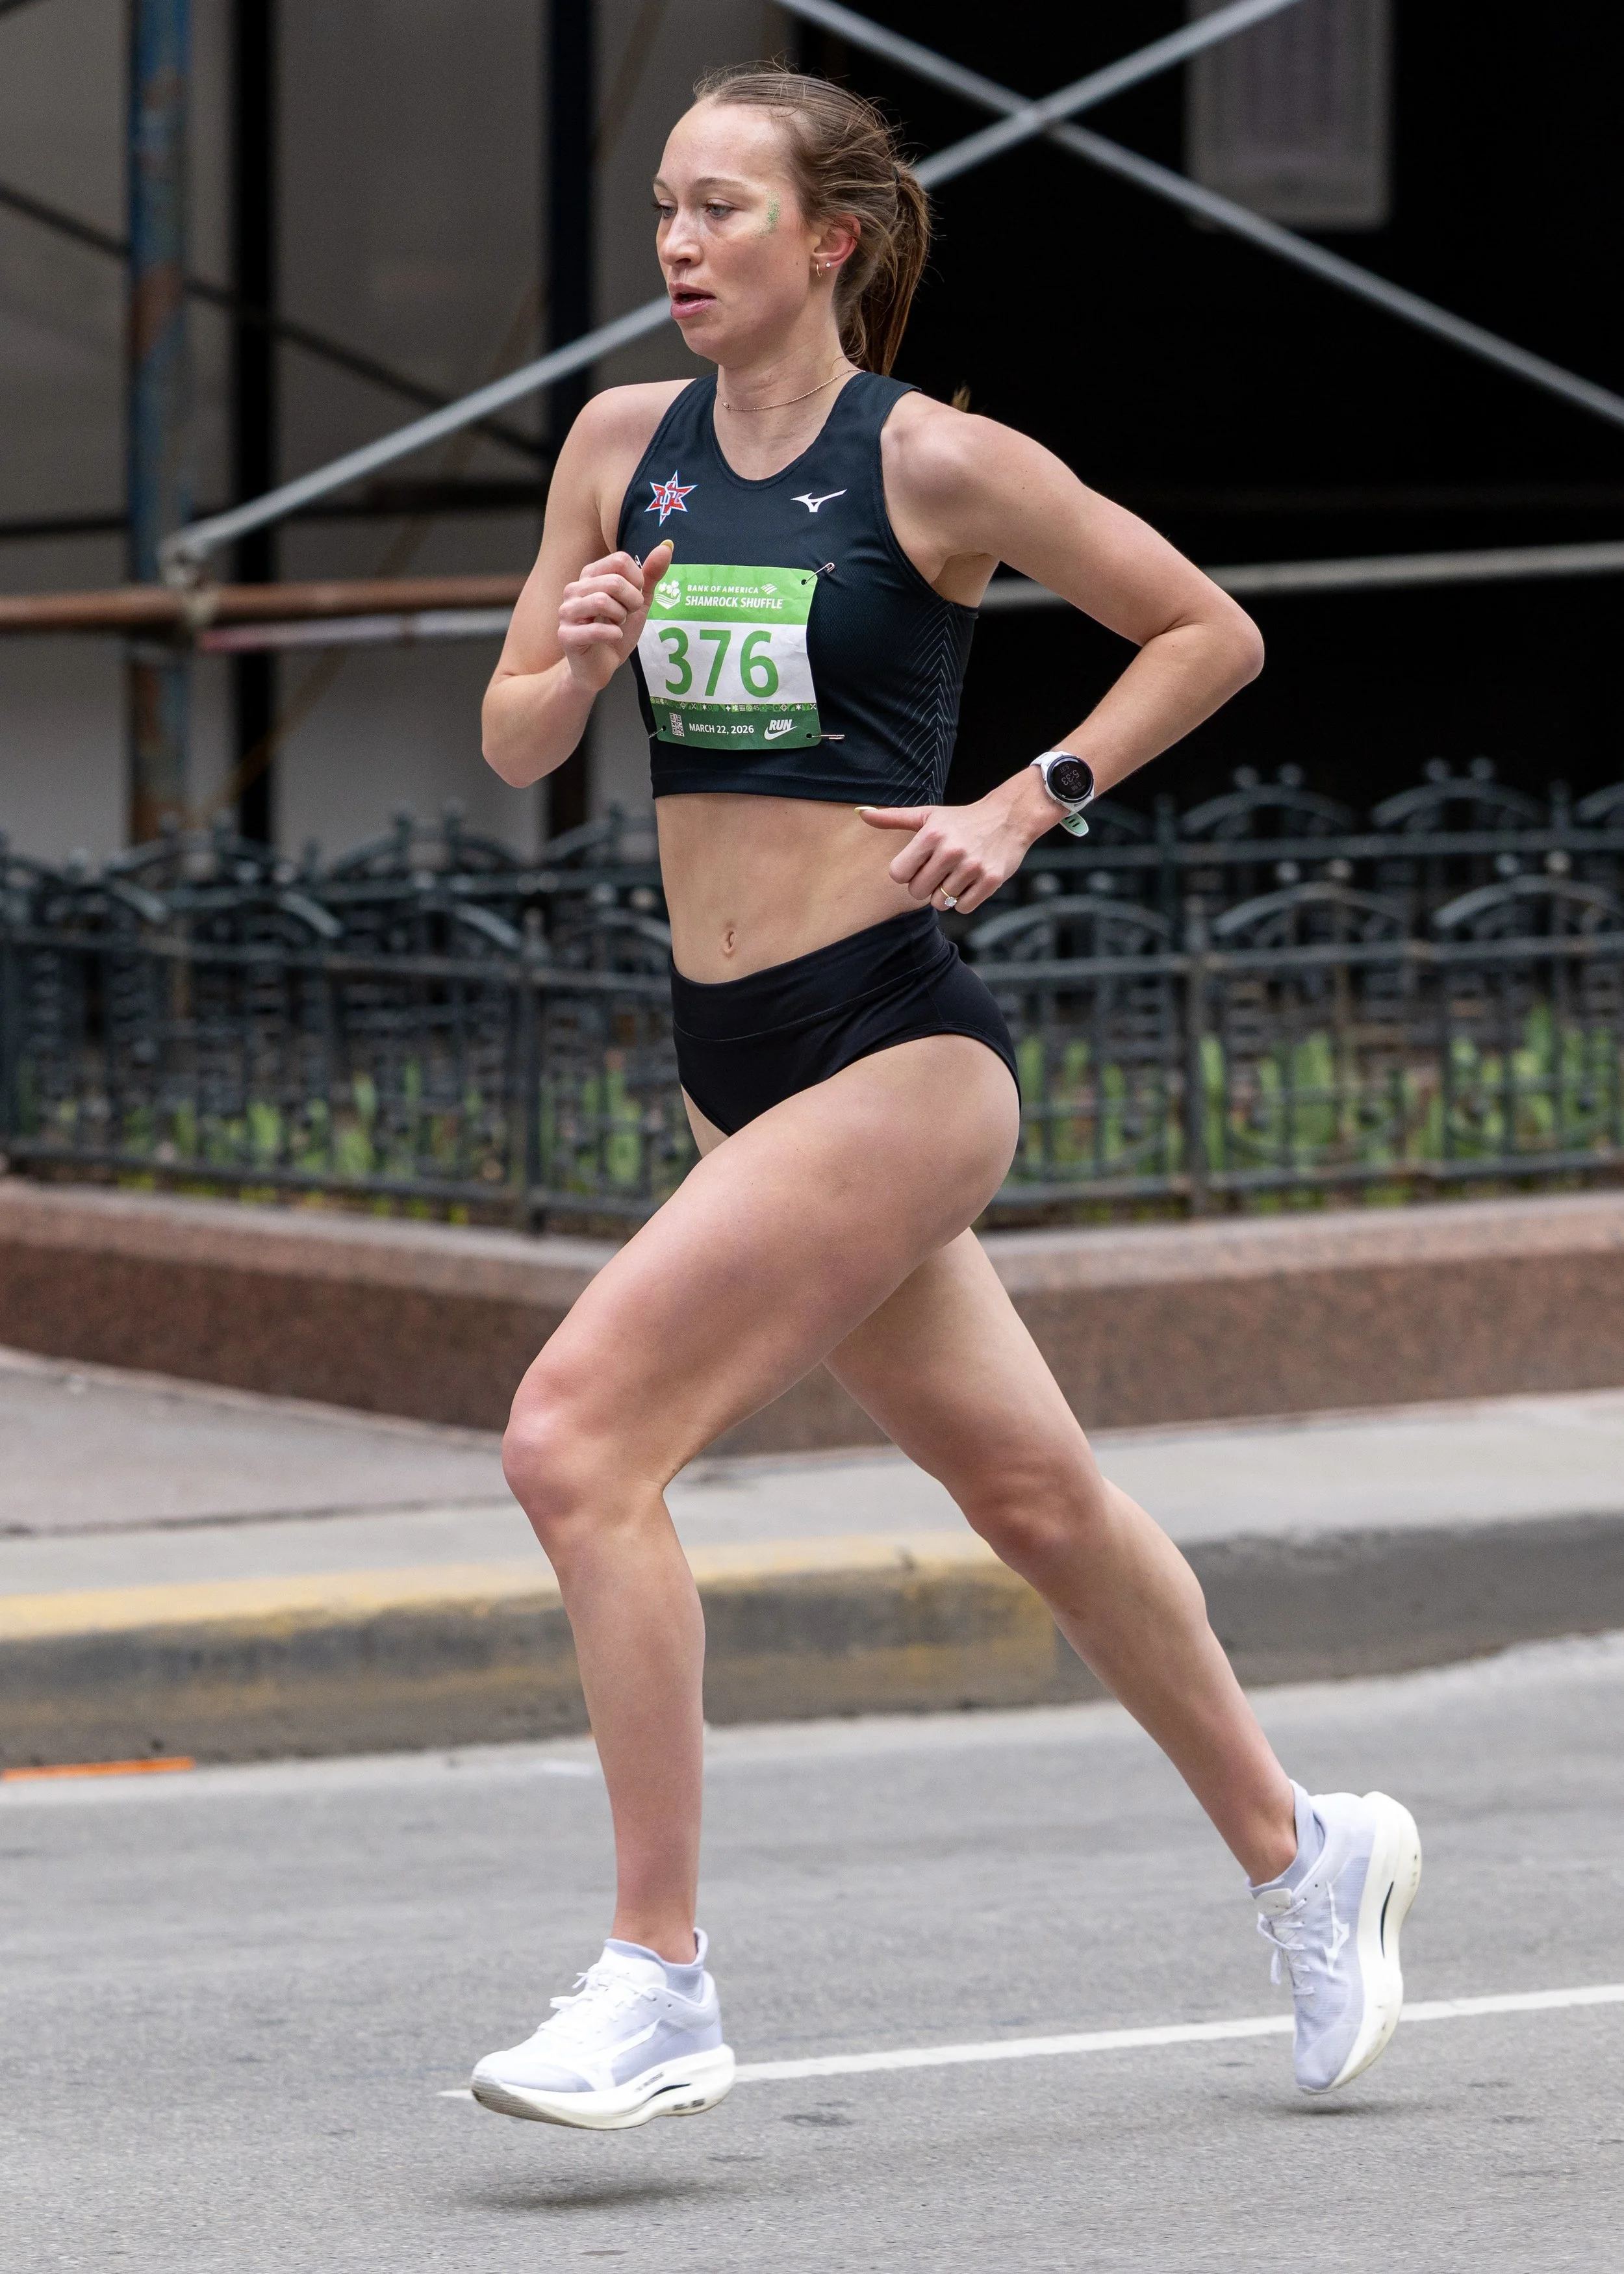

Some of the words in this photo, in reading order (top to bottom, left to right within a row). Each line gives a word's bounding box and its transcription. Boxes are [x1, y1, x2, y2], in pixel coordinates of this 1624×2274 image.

[685, 596, 739, 607] SHAMROCK
[741, 597, 783, 609] SHUFFLE
[658, 626, 780, 698] 376
[689, 723, 715, 733] MARCH
[717, 725, 729, 735] 22,
[731, 725, 754, 734] 2026
[769, 719, 793, 730] RUN
[1061, 770, 1080, 786] 5:33
